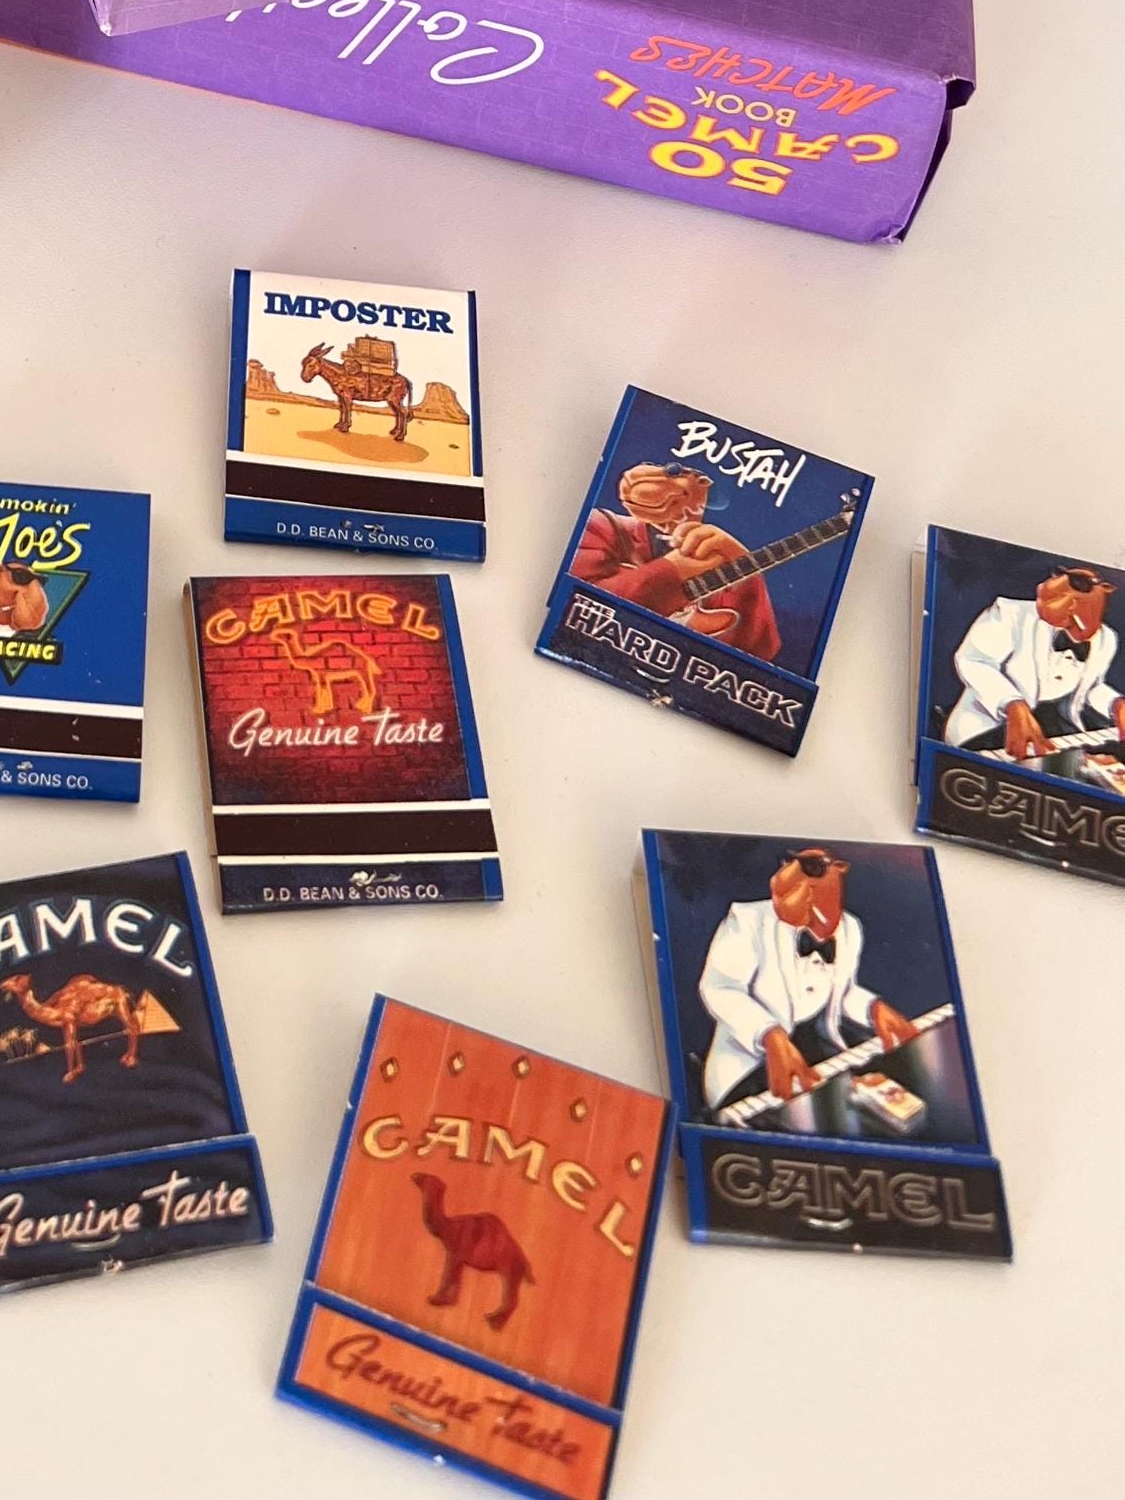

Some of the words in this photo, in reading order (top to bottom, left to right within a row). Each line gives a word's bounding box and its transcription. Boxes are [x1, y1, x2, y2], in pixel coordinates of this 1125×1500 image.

[629, 35, 897, 116] MATCHES
[594, 68, 901, 164] CAMEL
[691, 86, 798, 128] BOOK
[648, 140, 794, 196] 50
[264, 291, 454, 334] IMPOSTER
[309, 526, 349, 541] BEAN
[353, 530, 364, 542] &
[368, 531, 410, 547] SONS
[205, 590, 441, 644] CAMEL
[565, 602, 681, 674] HARD
[683, 655, 803, 728] PACK
[229, 707, 359, 756] Genuine
[361, 706, 443, 747] Taste
[1, 769, 13, 783] &
[18, 771, 61, 788] SONS
[300, 886, 344, 900] BEAN
[349, 886, 360, 899] &
[365, 885, 411, 899] SONS
[142, 1170, 249, 1229] Taste
[362, 1114, 635, 1259] CAMEL
[711, 1153, 995, 1231] CAMEL
[325, 1333, 478, 1424] Genuine
[481, 1395, 581, 1463] Taste
